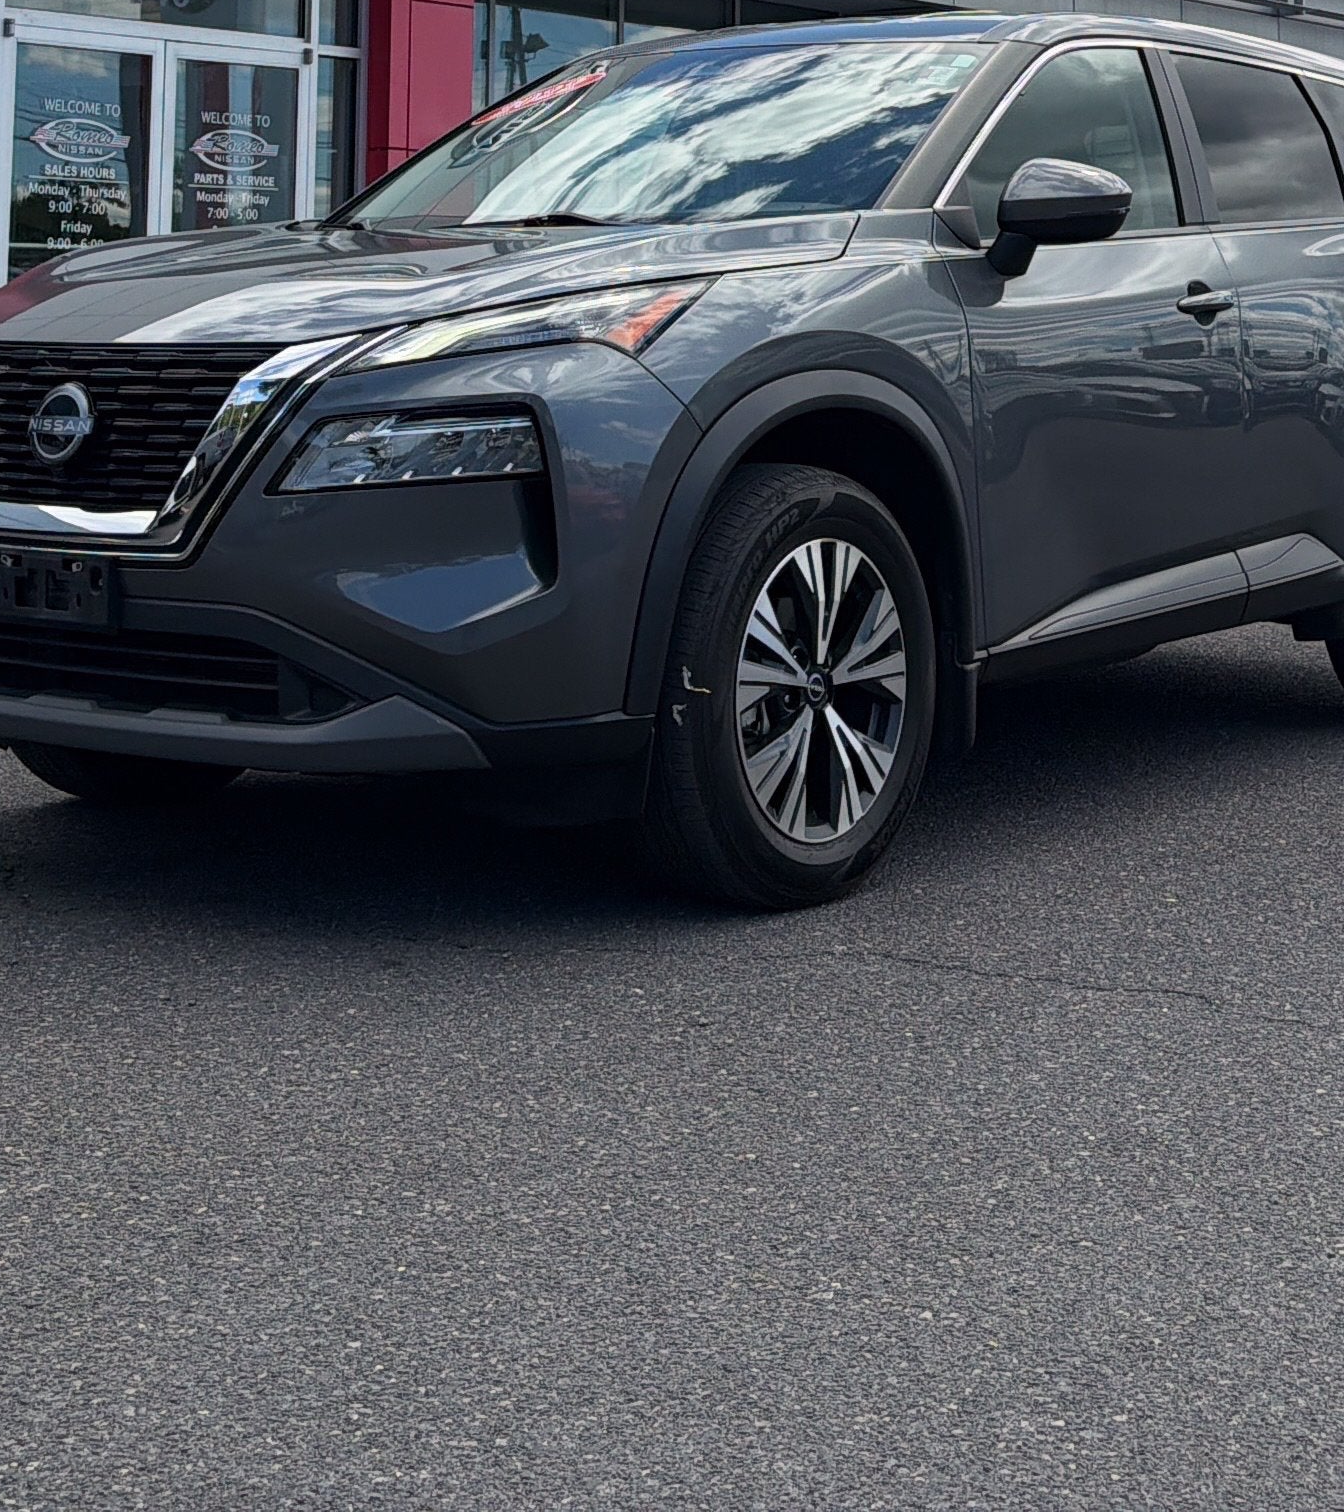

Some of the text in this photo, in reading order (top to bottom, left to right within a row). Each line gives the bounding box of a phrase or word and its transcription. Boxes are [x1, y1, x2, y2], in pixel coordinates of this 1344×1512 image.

[45, 98, 120, 118] WELCOME TO
[201, 111, 270, 127] WELCOME TO
[52, 120, 114, 144] Romeo
[57, 144, 103, 155] NISSAN
[44, 164, 115, 180] SALES HOURS
[194, 173, 274, 187] PARTS & SERVICE
[29, 181, 70, 197] Monday
[79, 185, 127, 201] Thursday
[196, 191, 233, 204] Monday
[242, 193, 269, 206] Friday
[48, 200, 72, 213] 9:00
[83, 203, 105, 215] 7:00
[208, 207, 229, 219] 7:00
[236, 209, 259, 221] 5:00
[60, 220, 93, 235] Friday
[30, 418, 90, 433] NISSAN
